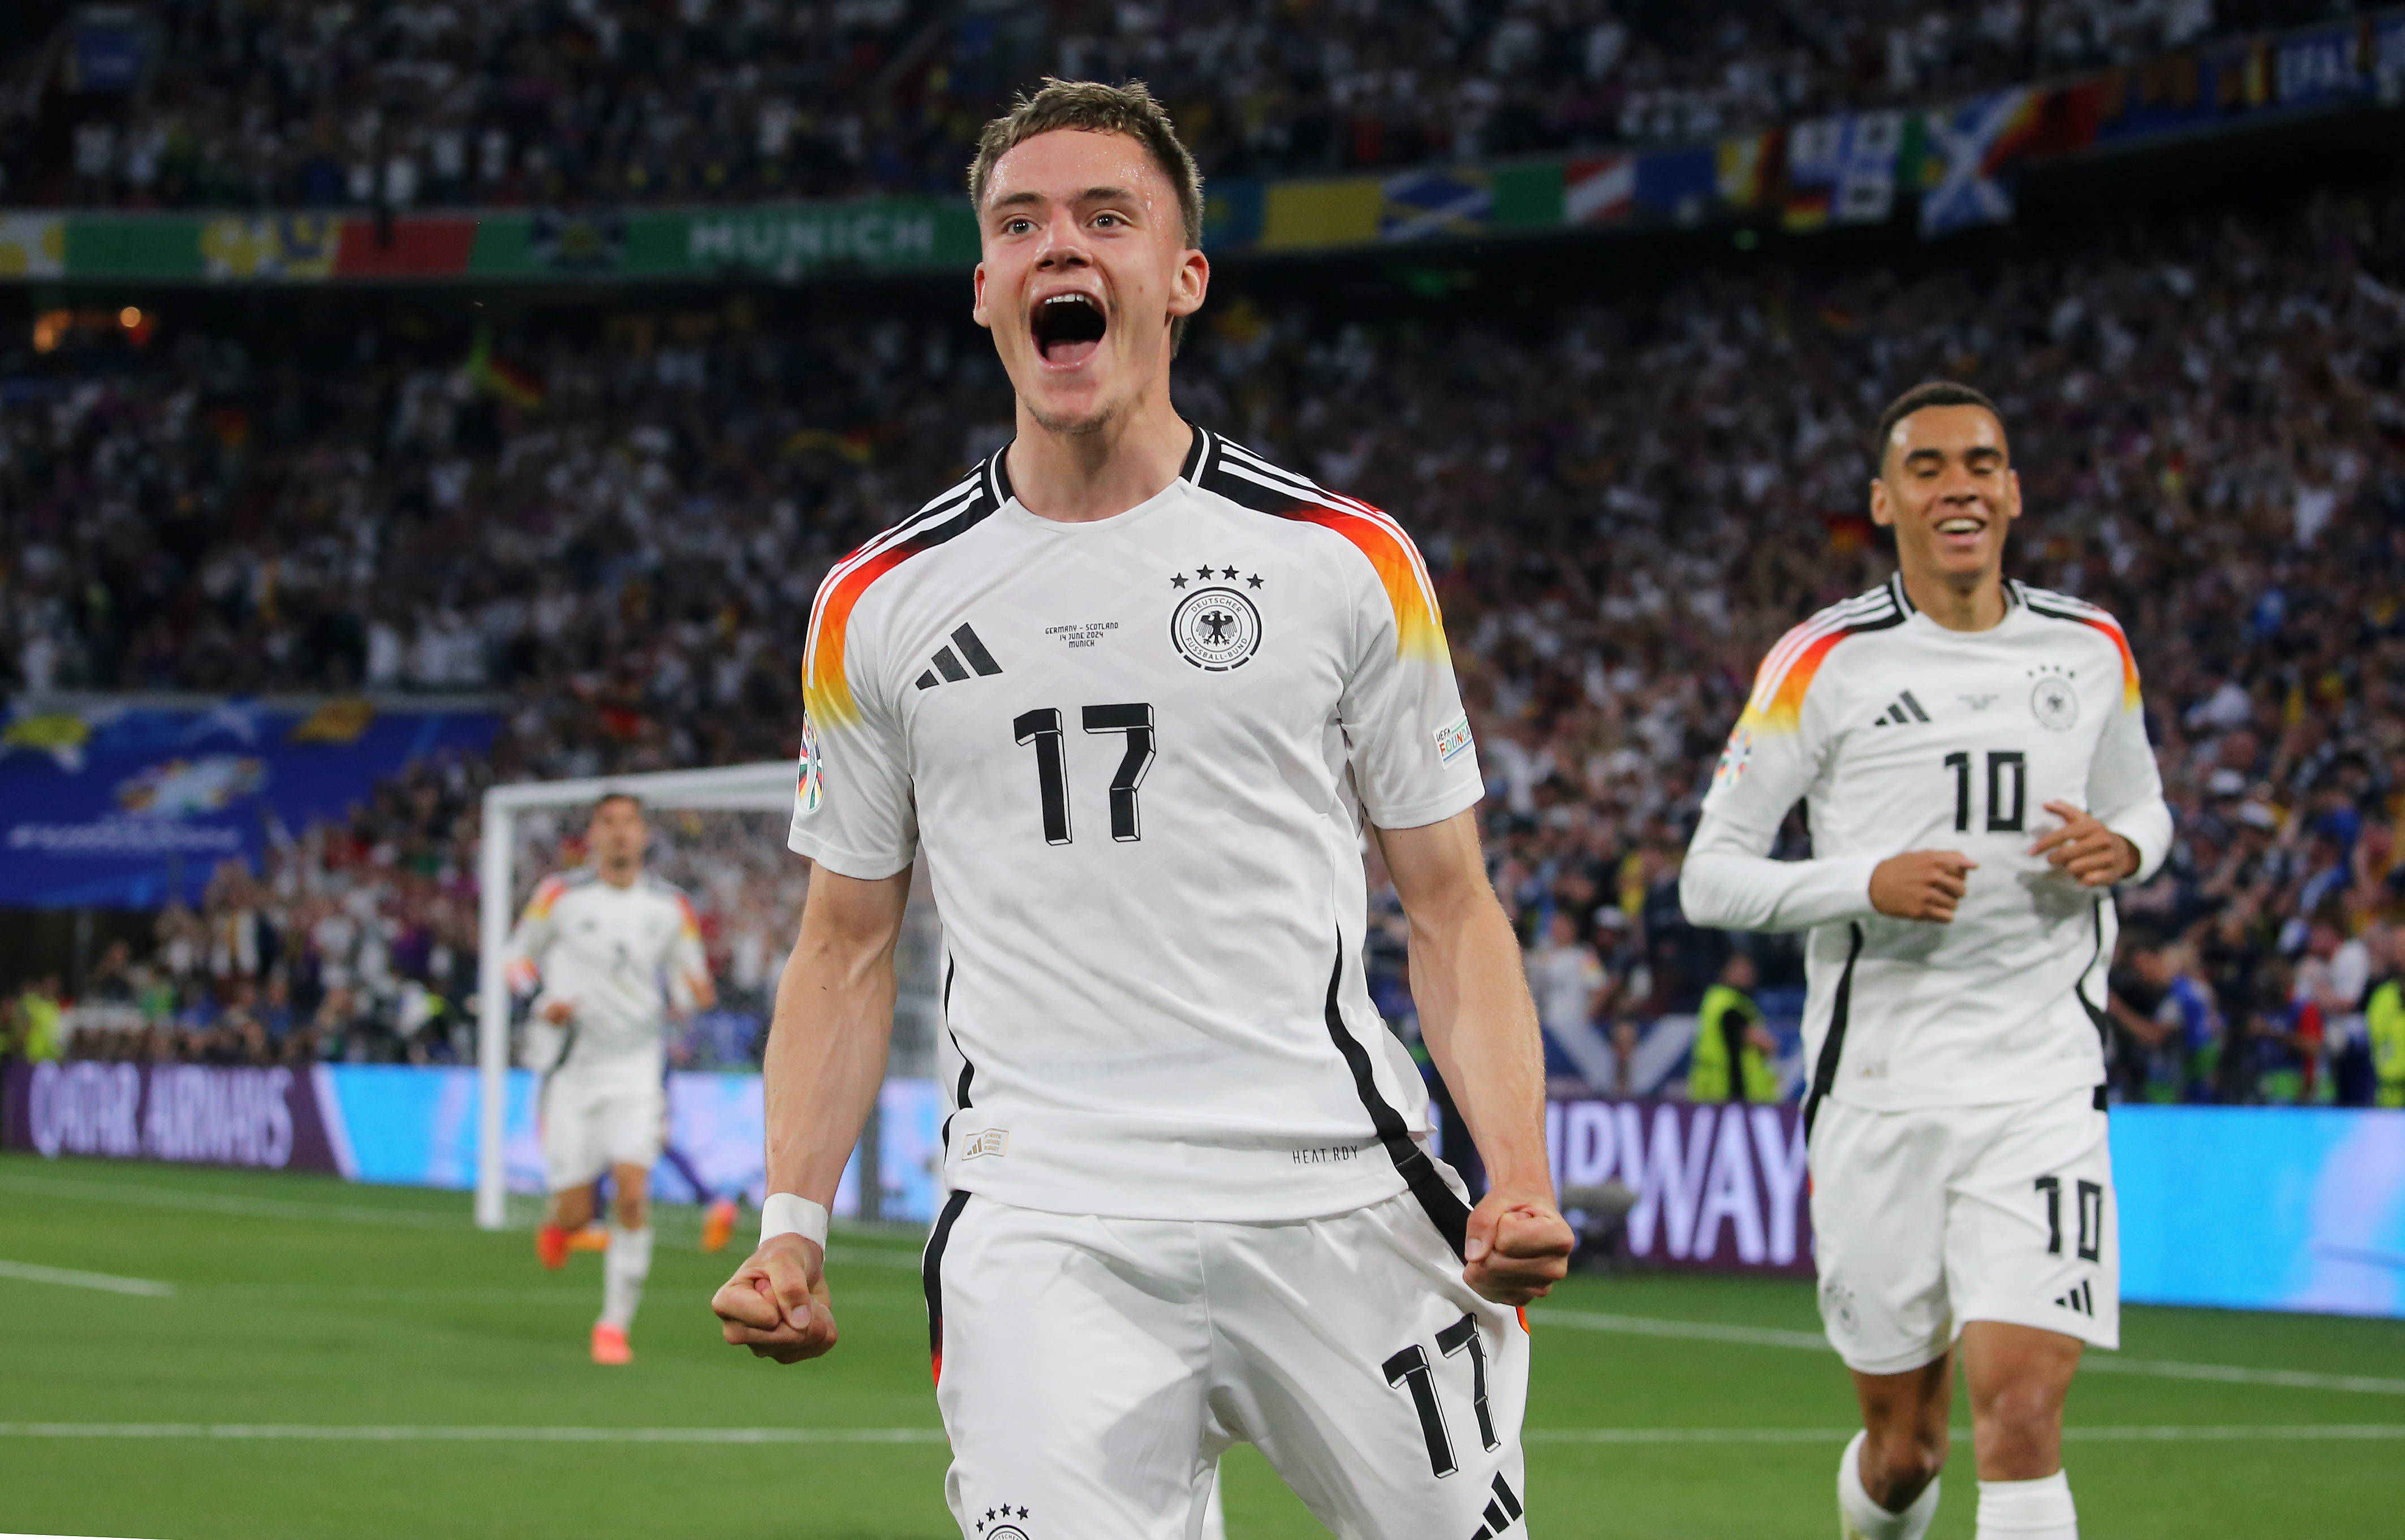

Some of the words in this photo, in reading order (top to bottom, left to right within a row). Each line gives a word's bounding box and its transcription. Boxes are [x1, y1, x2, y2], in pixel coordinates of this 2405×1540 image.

[689, 215, 934, 258] MUNICH
[1191, 597, 1242, 612] DEUTSCHER
[1045, 624, 1077, 635] GERMANY
[1085, 622, 1119, 631] SCOTLAND
[1068, 632, 1084, 640] JUNE
[1068, 640, 1095, 648] MUNICH
[1186, 637, 1248, 661] FUSSBALL-BUND
[1436, 727, 1451, 742] UEFA
[1013, 703, 1156, 846] 17
[1945, 751, 2026, 834] 10
[1292, 1145, 1357, 1164] HEAT.RDY
[2035, 1175, 2102, 1262] 10
[1381, 1312, 1502, 1479] 17
